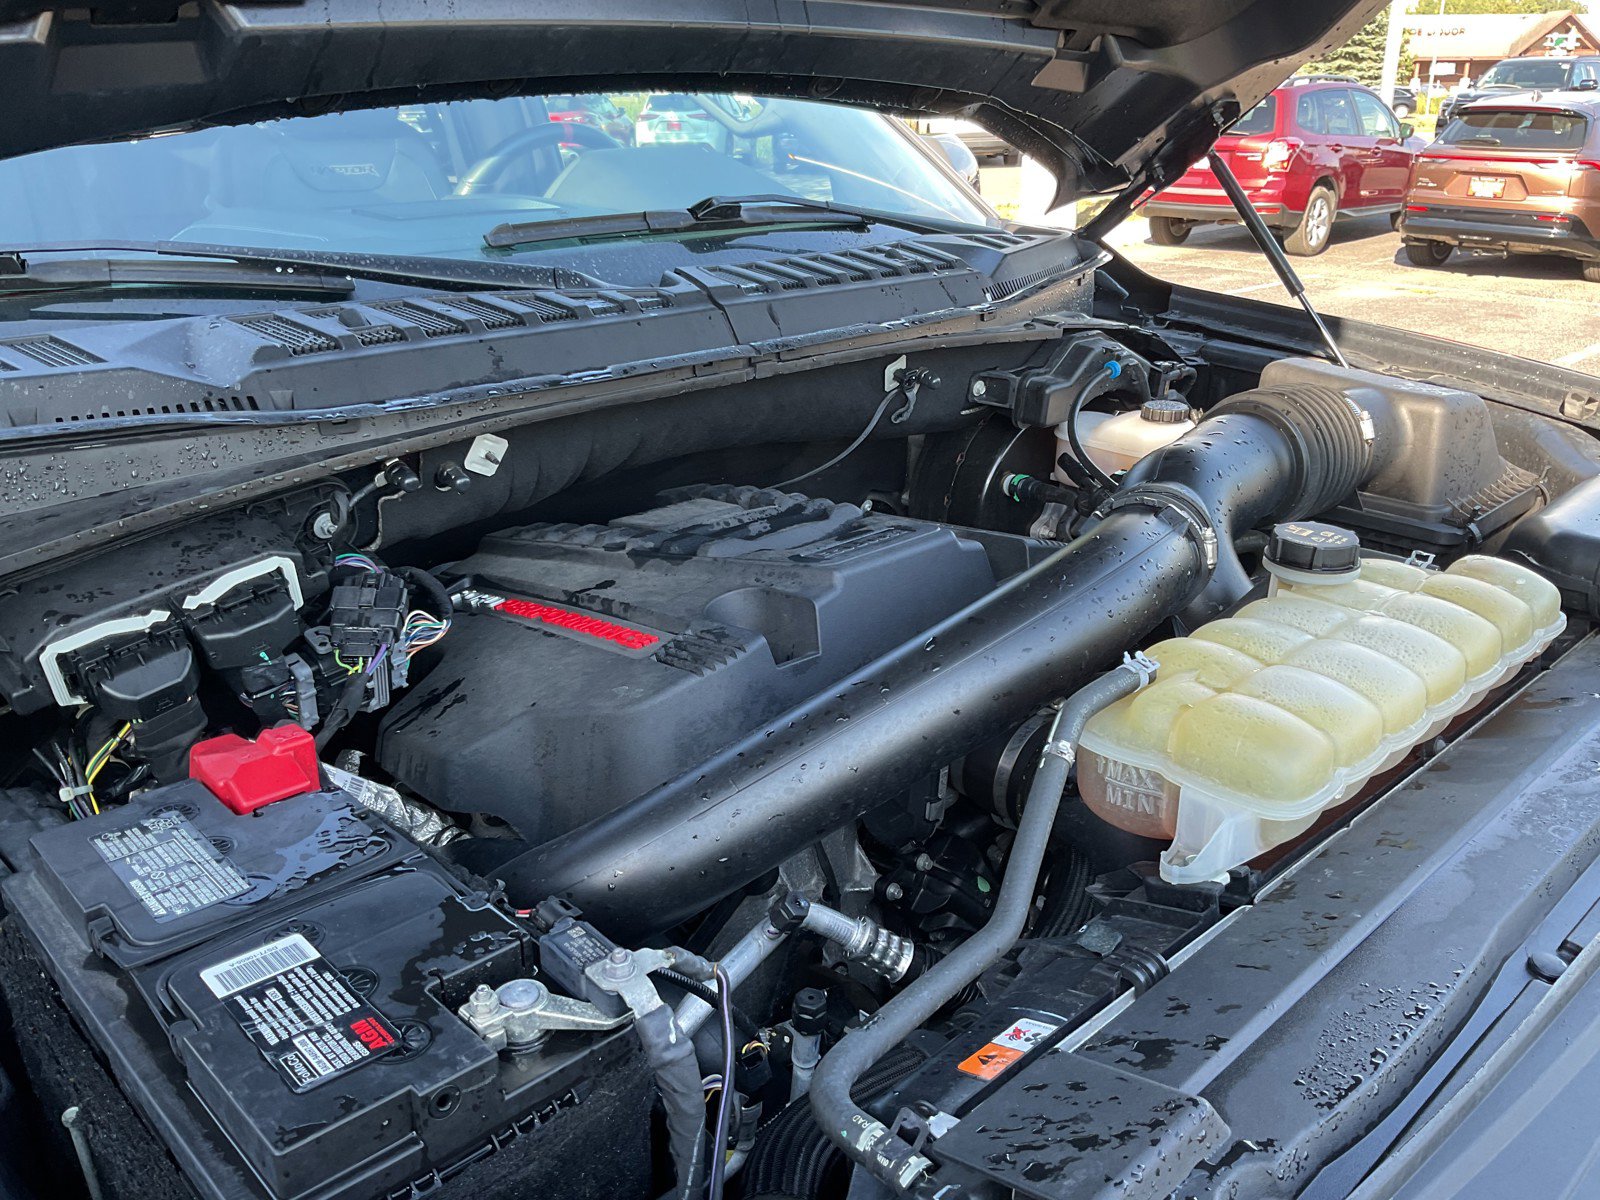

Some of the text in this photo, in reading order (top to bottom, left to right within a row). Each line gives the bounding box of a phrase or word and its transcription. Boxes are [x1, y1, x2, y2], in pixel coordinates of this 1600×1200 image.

[1427, 27, 1465, 36] LQUOR
[1106, 757, 1155, 790] MAX
[1106, 784, 1153, 815] MIN
[349, 1018, 388, 1052] AGM
[283, 1053, 314, 1083] FoMoCo
